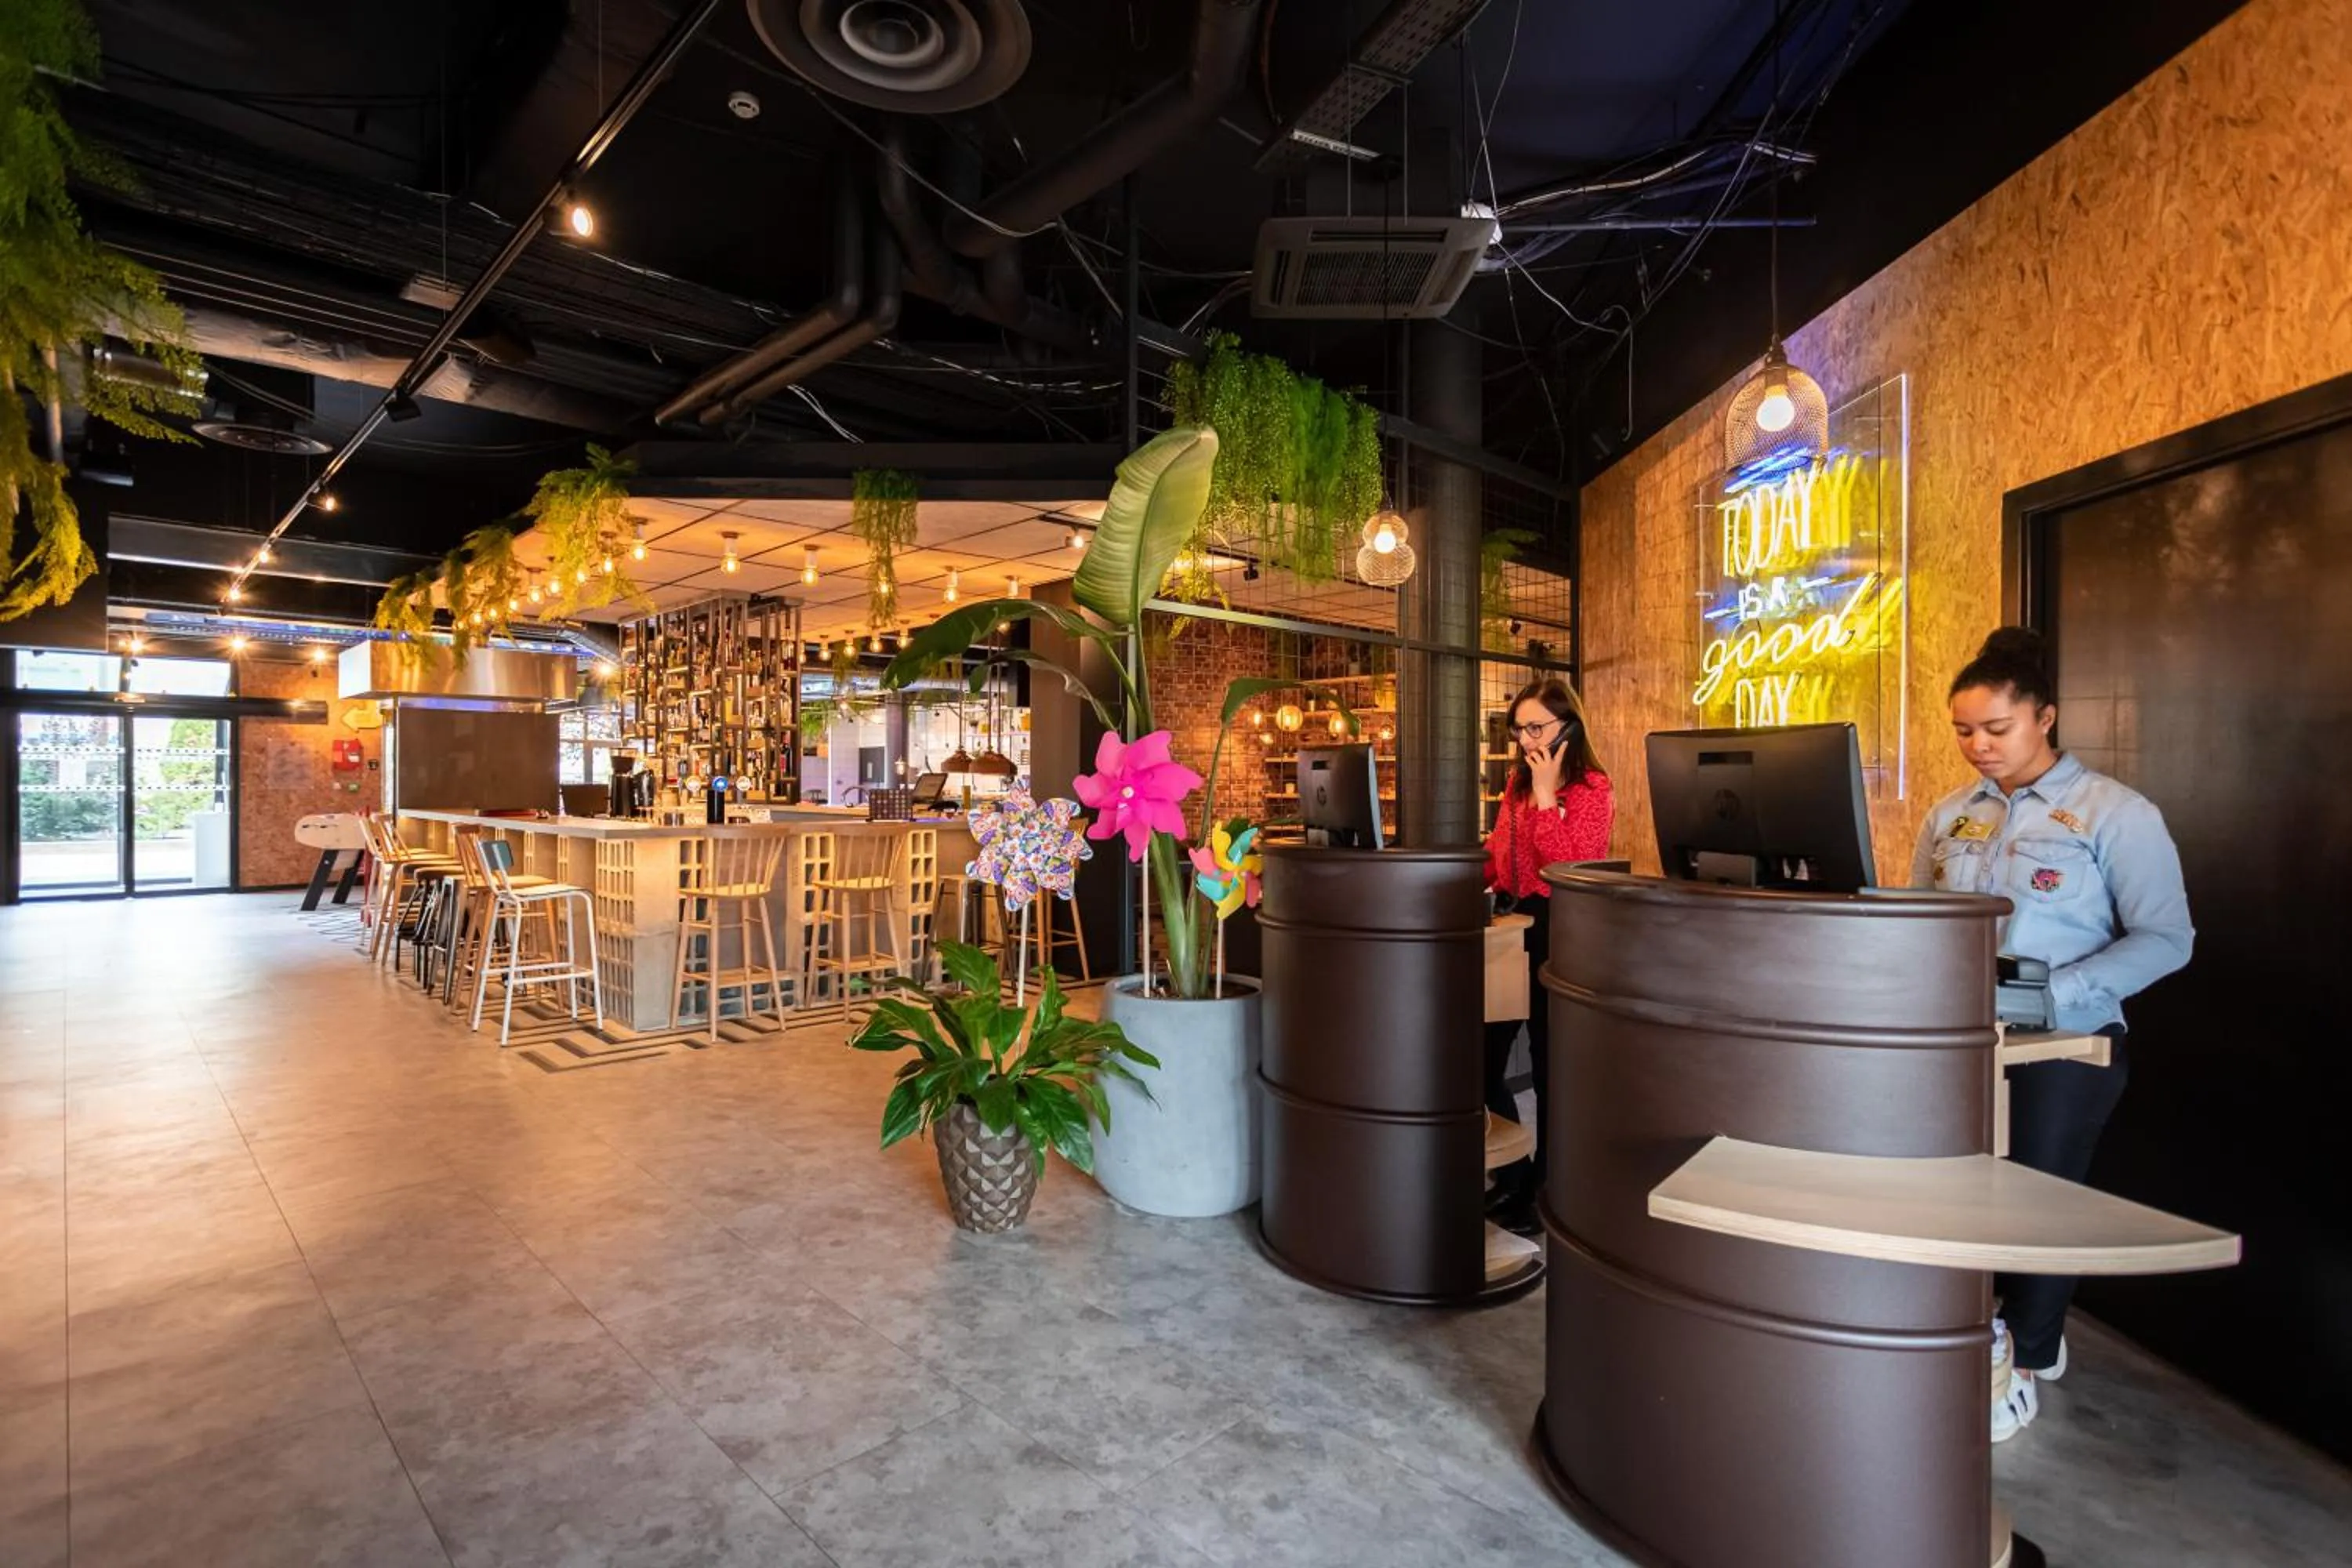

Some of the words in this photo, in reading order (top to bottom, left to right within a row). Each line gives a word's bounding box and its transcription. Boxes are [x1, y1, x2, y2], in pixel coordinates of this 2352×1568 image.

[1717, 456, 1824, 577] TODAY
[1693, 572, 1880, 705] good
[1739, 583, 1762, 621] IS
[1769, 576, 1790, 612] A
[1735, 670, 1801, 728] DAY
